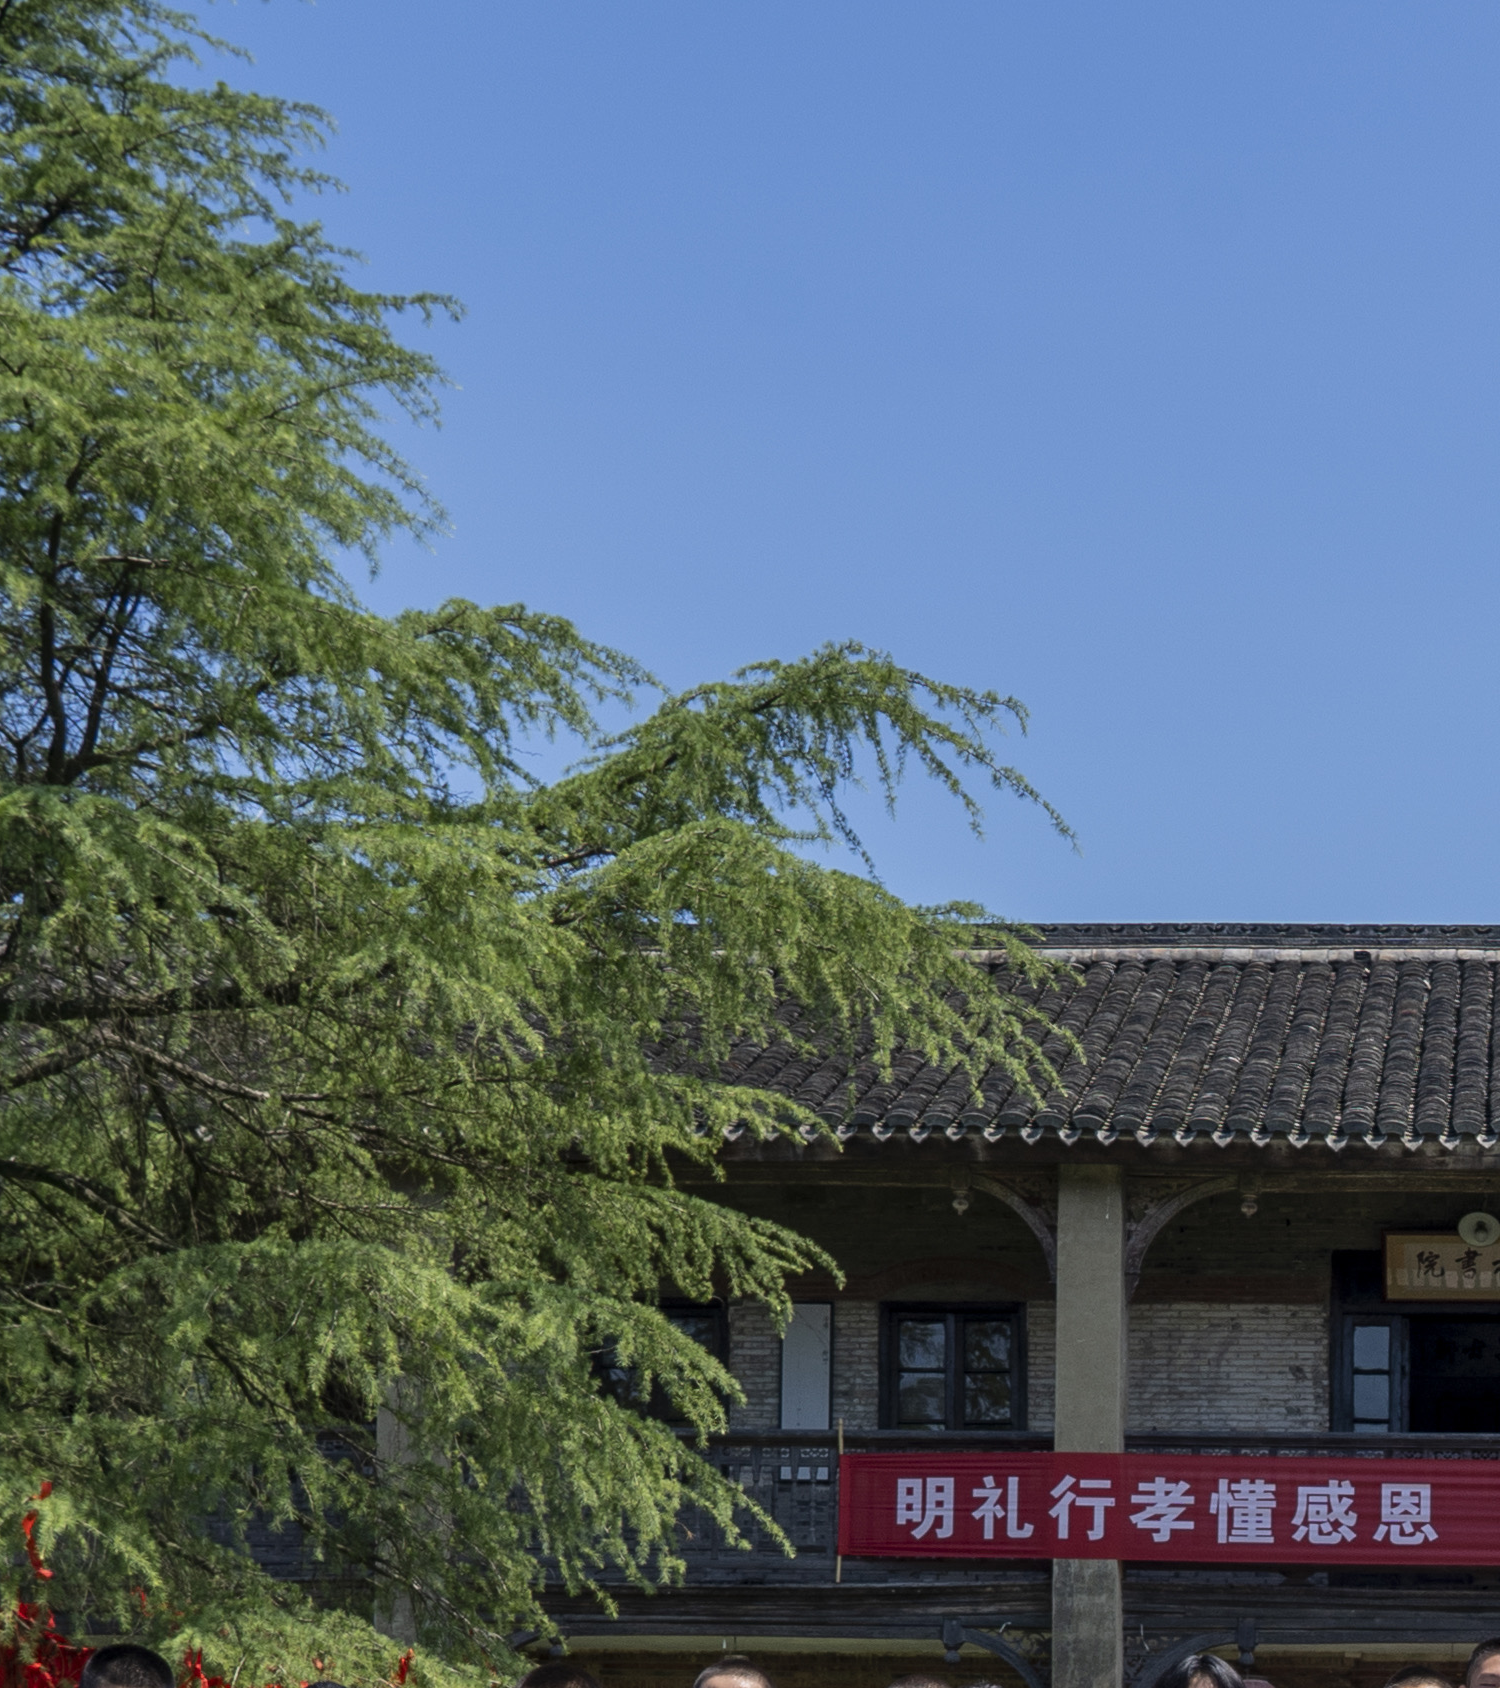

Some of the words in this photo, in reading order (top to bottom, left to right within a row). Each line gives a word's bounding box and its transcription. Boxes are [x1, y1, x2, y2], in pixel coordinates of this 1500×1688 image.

[896, 1474, 1439, 1546] 明礼行孝懂感恩
